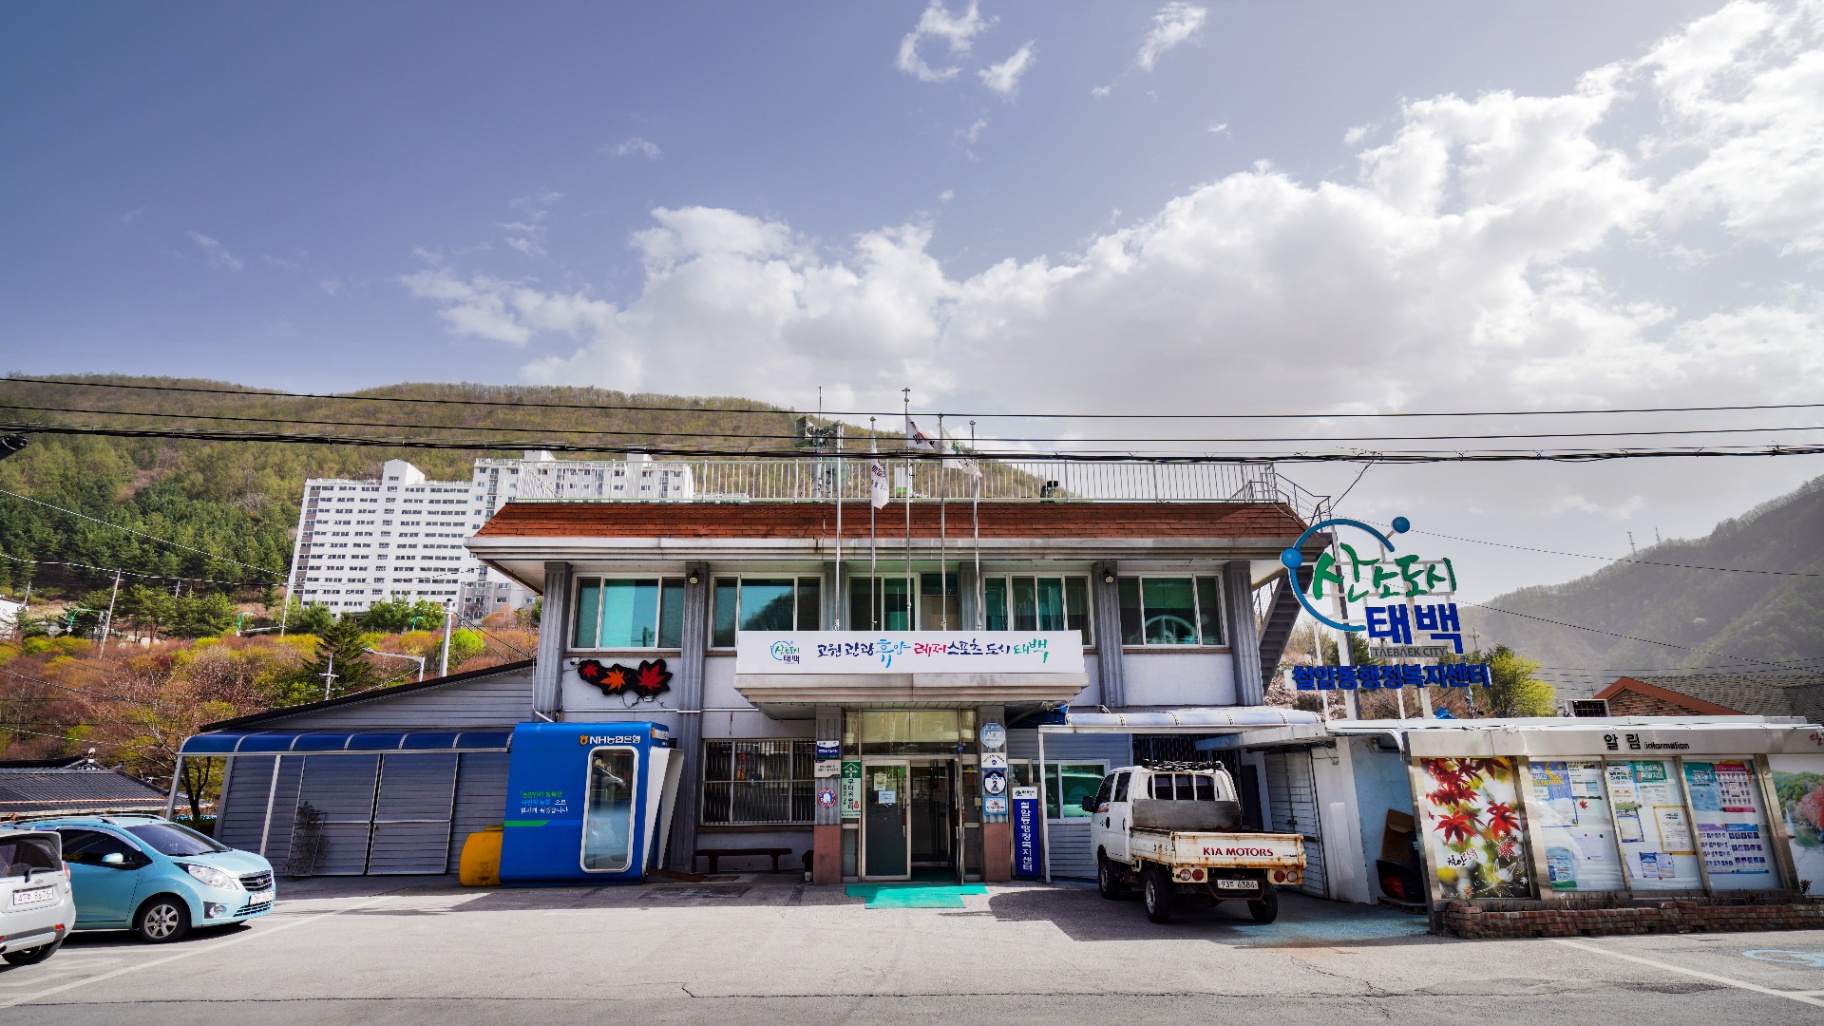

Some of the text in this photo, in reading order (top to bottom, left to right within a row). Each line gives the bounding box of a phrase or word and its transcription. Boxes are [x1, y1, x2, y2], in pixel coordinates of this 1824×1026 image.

[1365, 603, 1463, 654] 태백
[818, 643, 842, 657] 고원
[845, 642, 874, 656] 관광
[876, 638, 911, 668] 휴양
[986, 643, 1010, 655] 도시
[1014, 639, 1049, 663] 태백
[1373, 646, 1446, 657] TAEBAEK CITY
[1292, 662, 1492, 690] 철암동행정복지센터
[1203, 847, 1273, 857] KIA MOTORS
